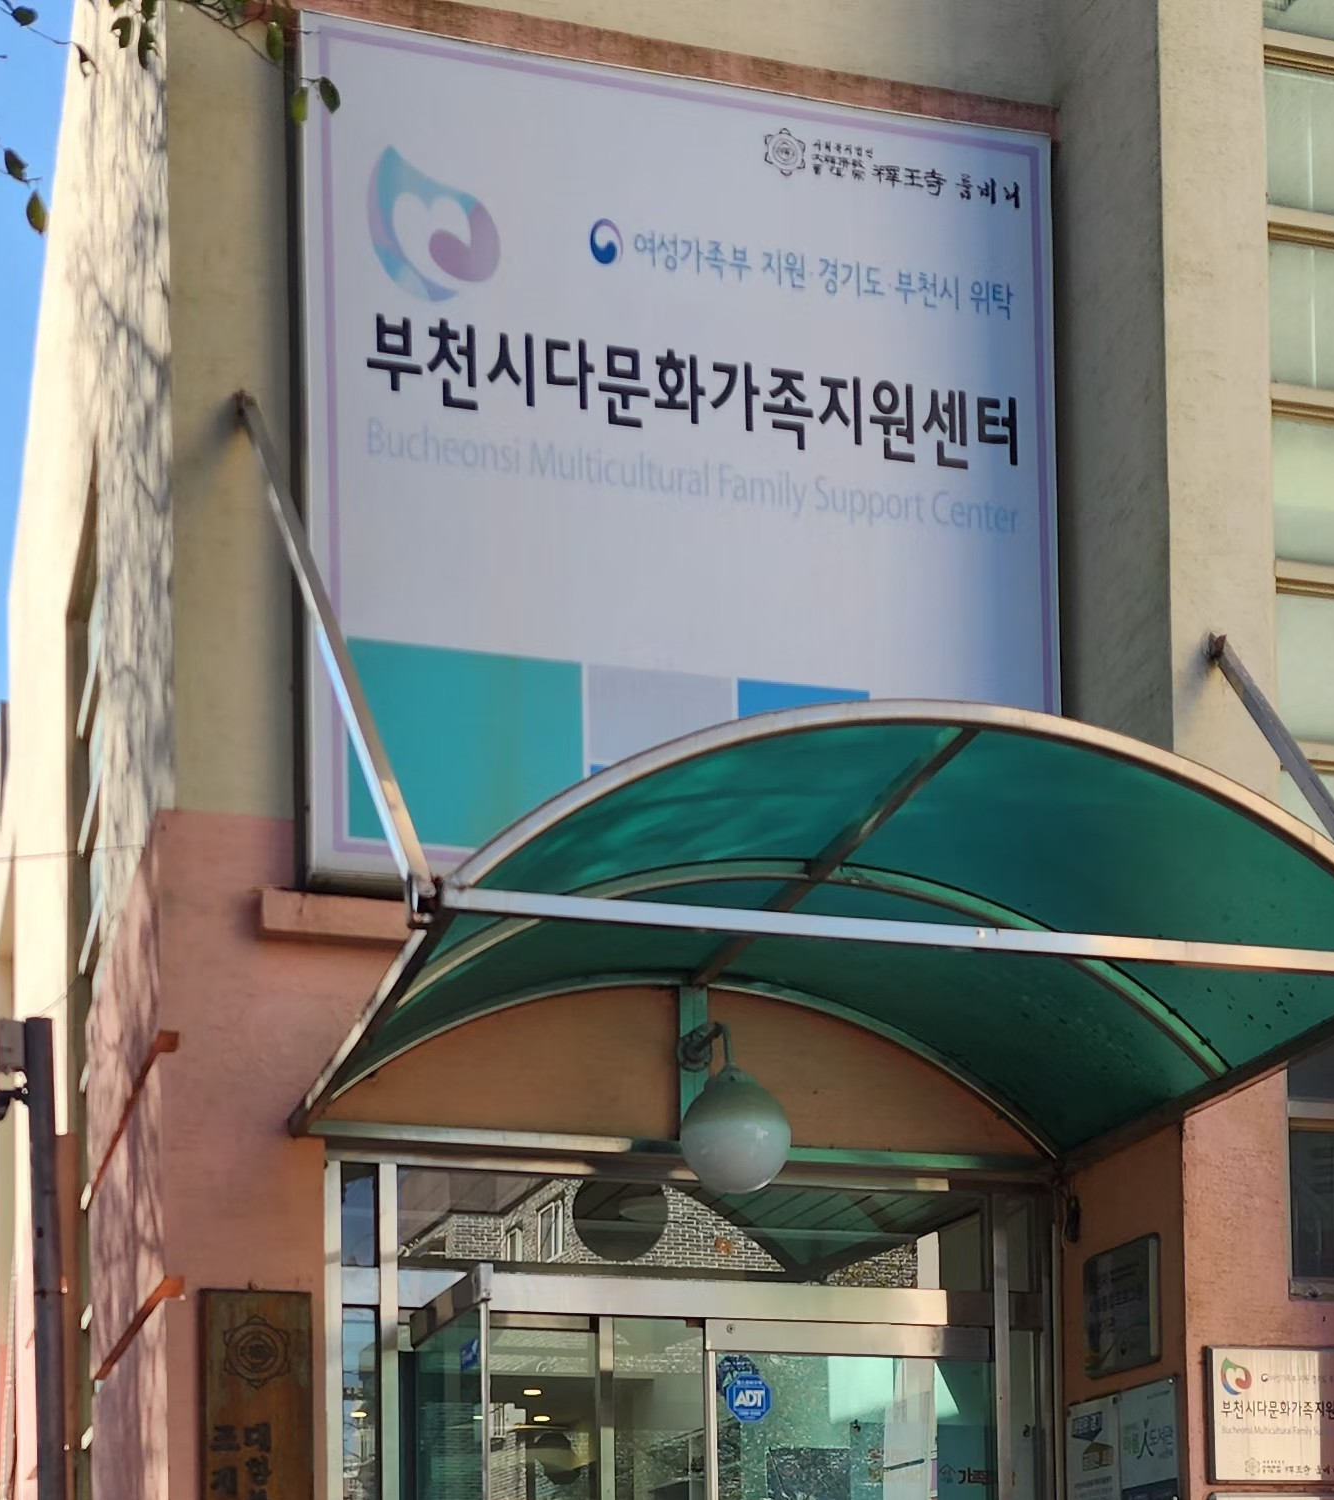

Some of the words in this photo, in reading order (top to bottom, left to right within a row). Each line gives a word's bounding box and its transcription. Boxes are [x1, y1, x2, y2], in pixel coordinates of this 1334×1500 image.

[634, 229, 750, 279] 여성가족부
[970, 272, 1015, 321] 위탁
[367, 312, 1020, 473] 부천시다문화가족지원센터
[367, 417, 522, 477] Bucheonsi
[529, 442, 710, 498] Multicultural
[719, 464, 808, 521] Family
[813, 475, 925, 527] Support
[932, 490, 1018, 535] Center
[735, 1390, 765, 1407] ADT
